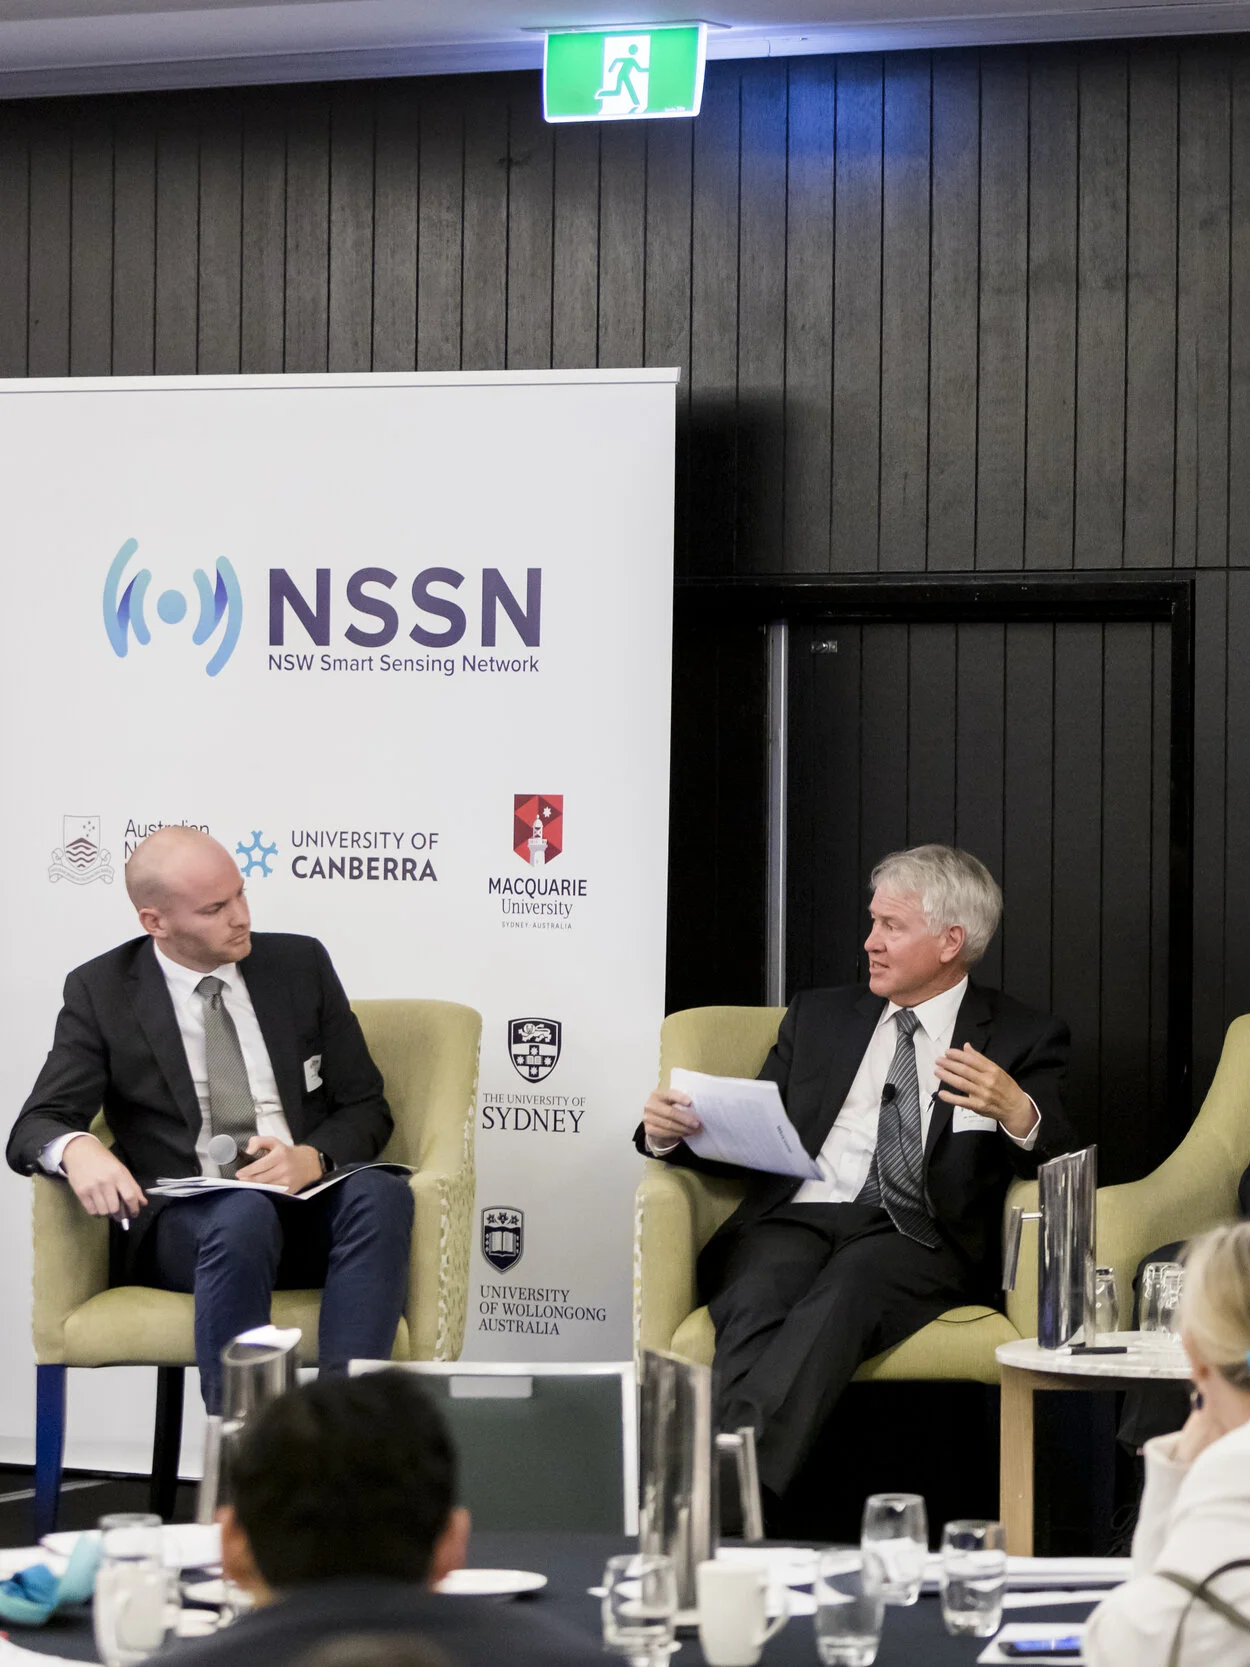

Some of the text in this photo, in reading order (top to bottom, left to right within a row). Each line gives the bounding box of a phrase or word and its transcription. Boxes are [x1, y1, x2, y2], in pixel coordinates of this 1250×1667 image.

[269, 567, 542, 648] NSSN
[268, 654, 540, 676] NSW Smart Sensing Network
[291, 830, 439, 850] UNIVERSITY OF
[291, 855, 438, 882] CANBERRA
[488, 877, 587, 899] MACQUARIE
[501, 898, 573, 919] University
[483, 1093, 586, 1107] THE UNIVERSITY OF
[482, 1106, 586, 1133] SYDNEY
[480, 1285, 570, 1302] UNIVERSITY
[479, 1301, 607, 1321] OF WOLLONGONG
[478, 1318, 560, 1335] AUSTRALIA
